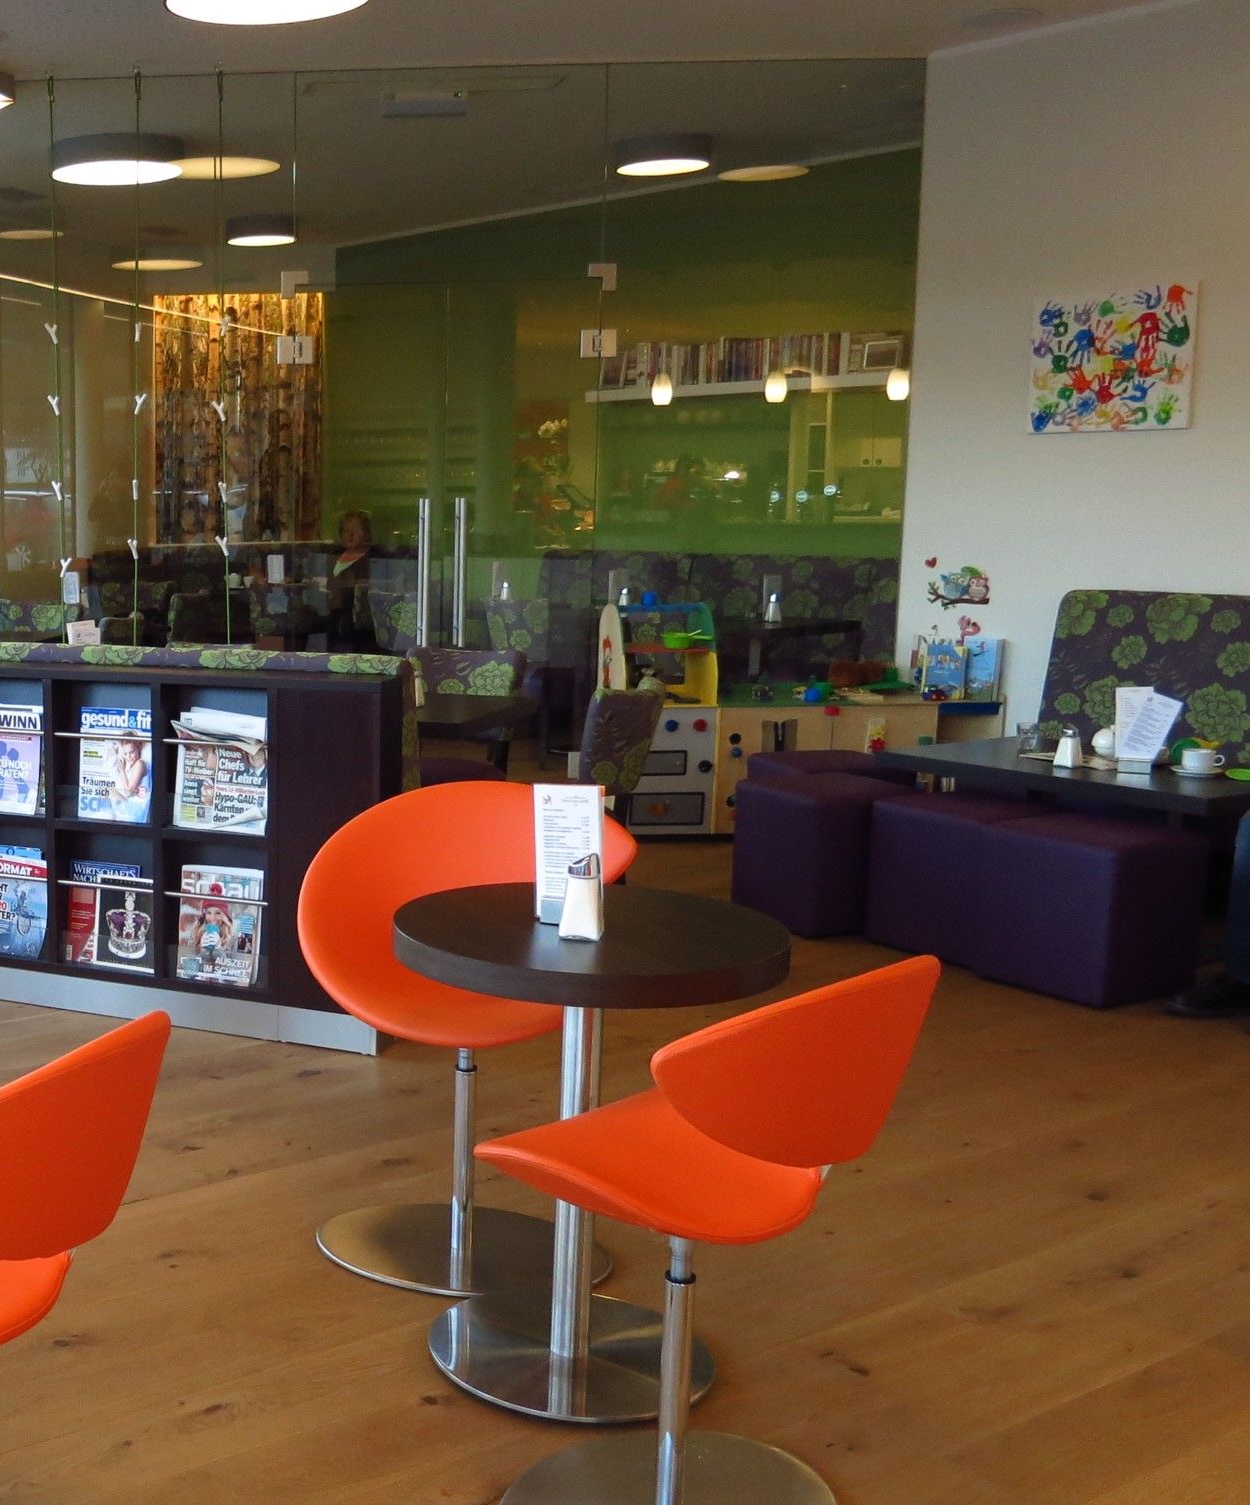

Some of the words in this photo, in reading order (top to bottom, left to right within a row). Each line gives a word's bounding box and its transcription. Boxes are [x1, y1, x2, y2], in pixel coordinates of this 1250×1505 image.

[219, 748, 243, 759] Neue
[10, 759, 32, 771] NOCH
[219, 758, 245, 771] Chefs
[82, 776, 116, 788] Träumen
[217, 770, 233, 782] für
[233, 772, 263, 786] Lehrer
[81, 786, 93, 795] Sie
[94, 787, 110, 797] sich
[214, 802, 245, 814] Kärnten
[214, 956, 250, 968] AUSZEIT
[203, 964, 213, 973] IM
[214, 965, 248, 978] SCHNEE
